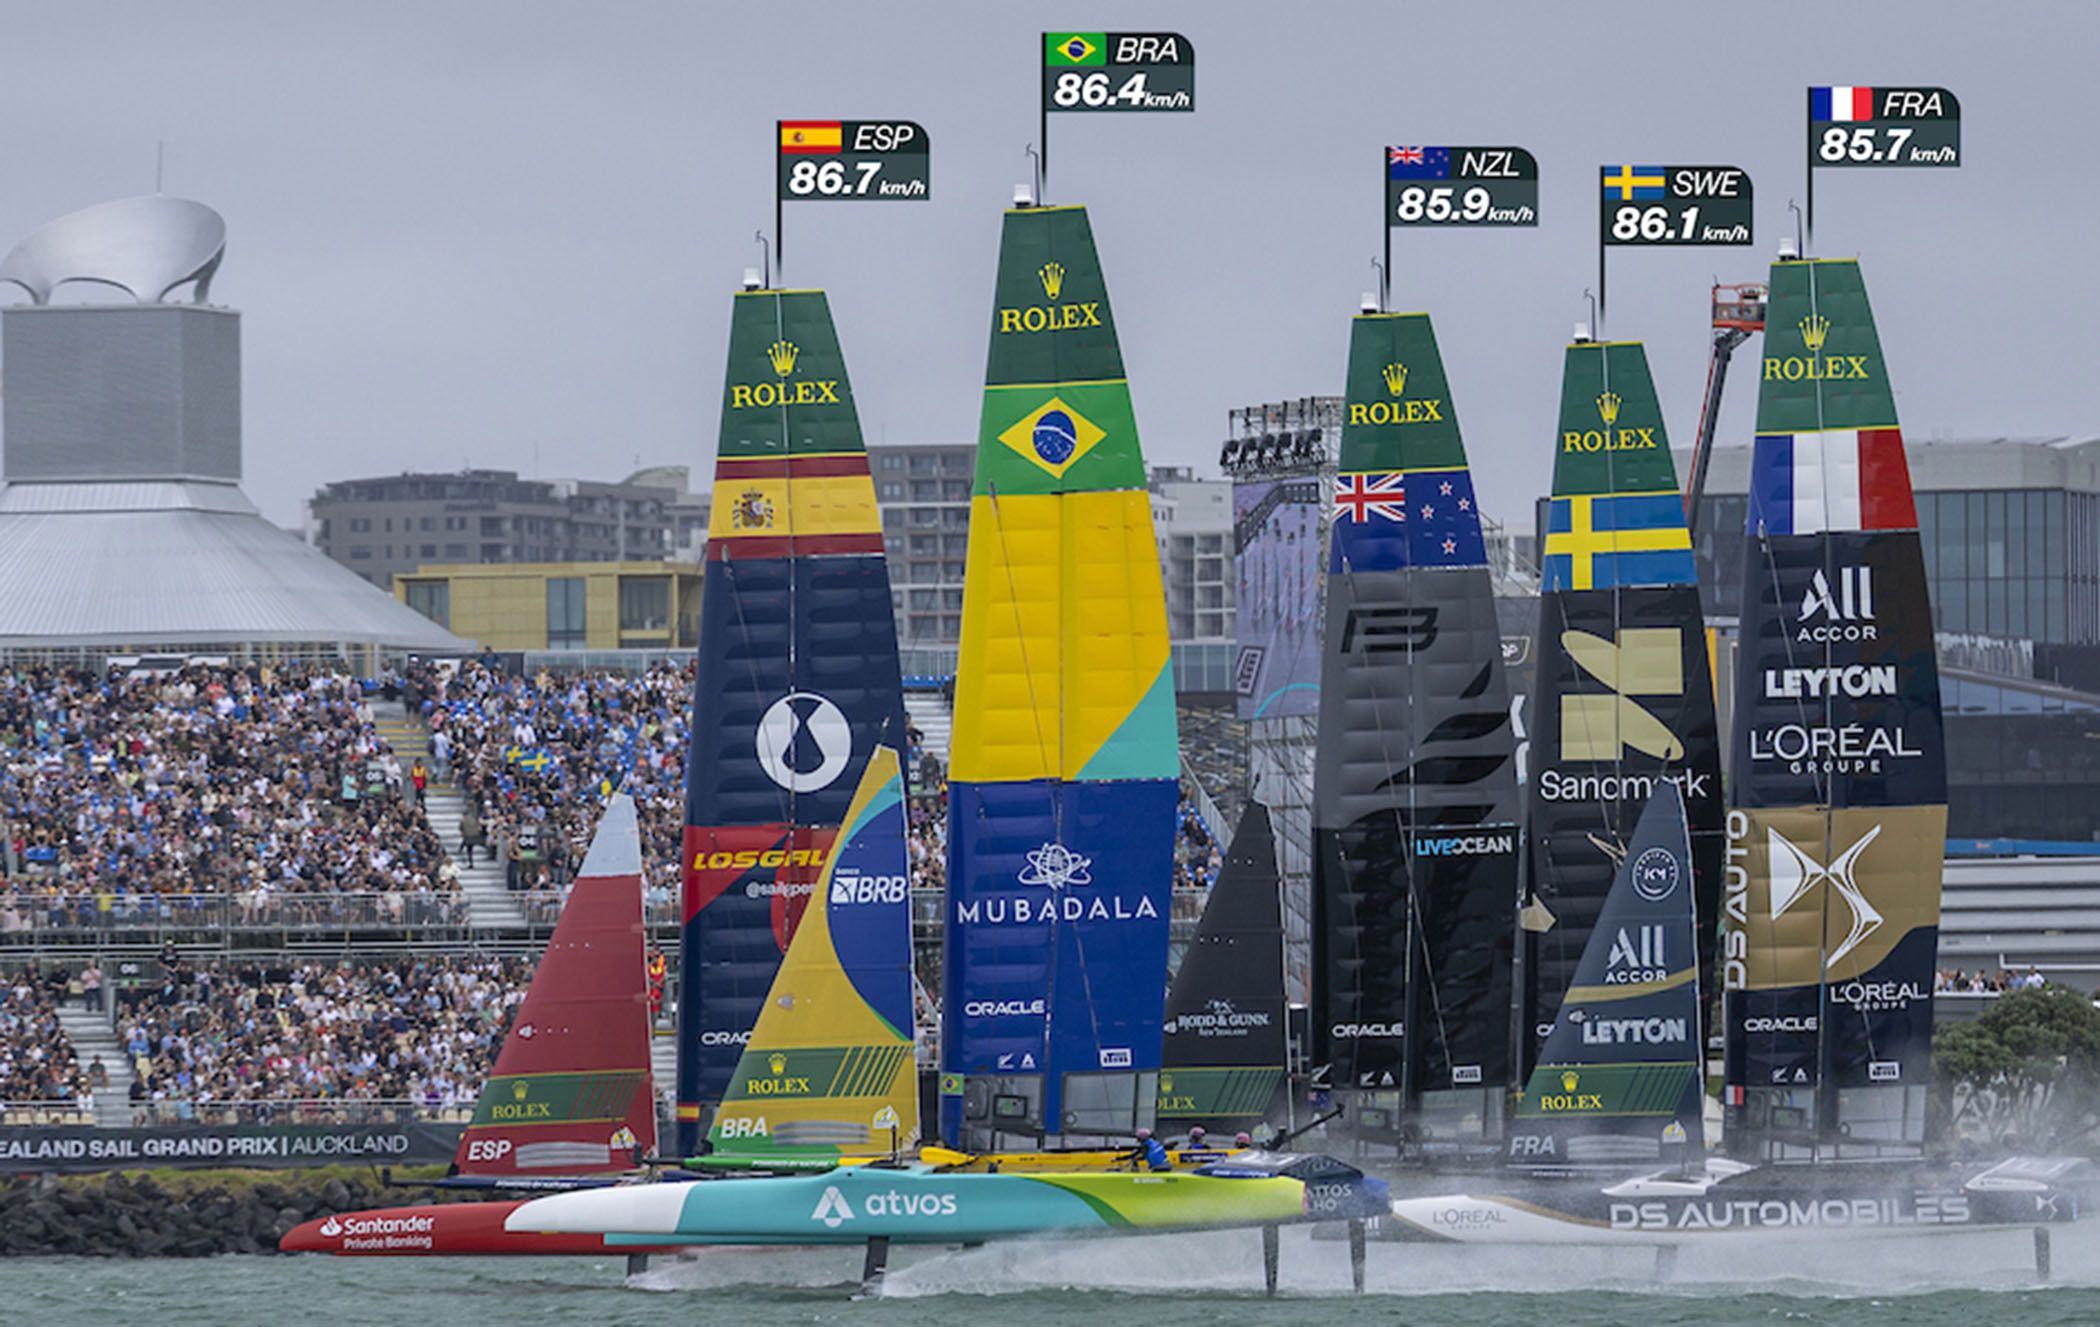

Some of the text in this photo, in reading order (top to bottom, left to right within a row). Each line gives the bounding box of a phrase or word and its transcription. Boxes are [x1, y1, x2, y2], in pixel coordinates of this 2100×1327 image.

[1000, 302, 1101, 333] ROLEX
[1763, 355, 1869, 381] ROLEX
[731, 380, 839, 408] ROLEX
[1349, 399, 1443, 425] ROLEX
[1563, 427, 1657, 453] ROLEX
[1797, 625, 1877, 642] ACCOR
[1765, 664, 1897, 698] LEYTON
[1750, 722, 1923, 760] L'ORÉAL
[1790, 760, 1881, 775] GROUPE
[857, 875, 907, 904] BRB
[1726, 809, 1749, 991] DS AUTO
[957, 895, 1159, 924] MUBADALA
[1605, 969, 1667, 984] ACCOR
[1829, 980, 1929, 1004] L'ORÉAL
[964, 999, 1045, 1016] ORACLE
[1854, 1001, 1907, 1010] GROUPE
[1331, 1022, 1404, 1038] ORACLE
[1582, 1017, 1688, 1044] LEYTON
[1744, 1016, 1818, 1032] ORACLE
[748, 1077, 810, 1096] ROLEX
[492, 1102, 551, 1120] ROLEX
[1540, 1094, 1604, 1111] ROLEX
[720, 1116, 769, 1139] BRA
[88, 1138, 140, 1158] SAIL
[142, 1136, 224, 1157] GRAND
[226, 1135, 278, 1156] PRIX
[290, 1133, 410, 1154] AUCKLAND
[468, 1139, 512, 1161] ESP
[1509, 1135, 1557, 1156] FRA
[865, 1189, 958, 1217] atvos
[1609, 1196, 1971, 1230] DS AUTOMOBILES
[343, 1215, 435, 1236] Santander
[343, 1236, 433, 1250] Private Banking
